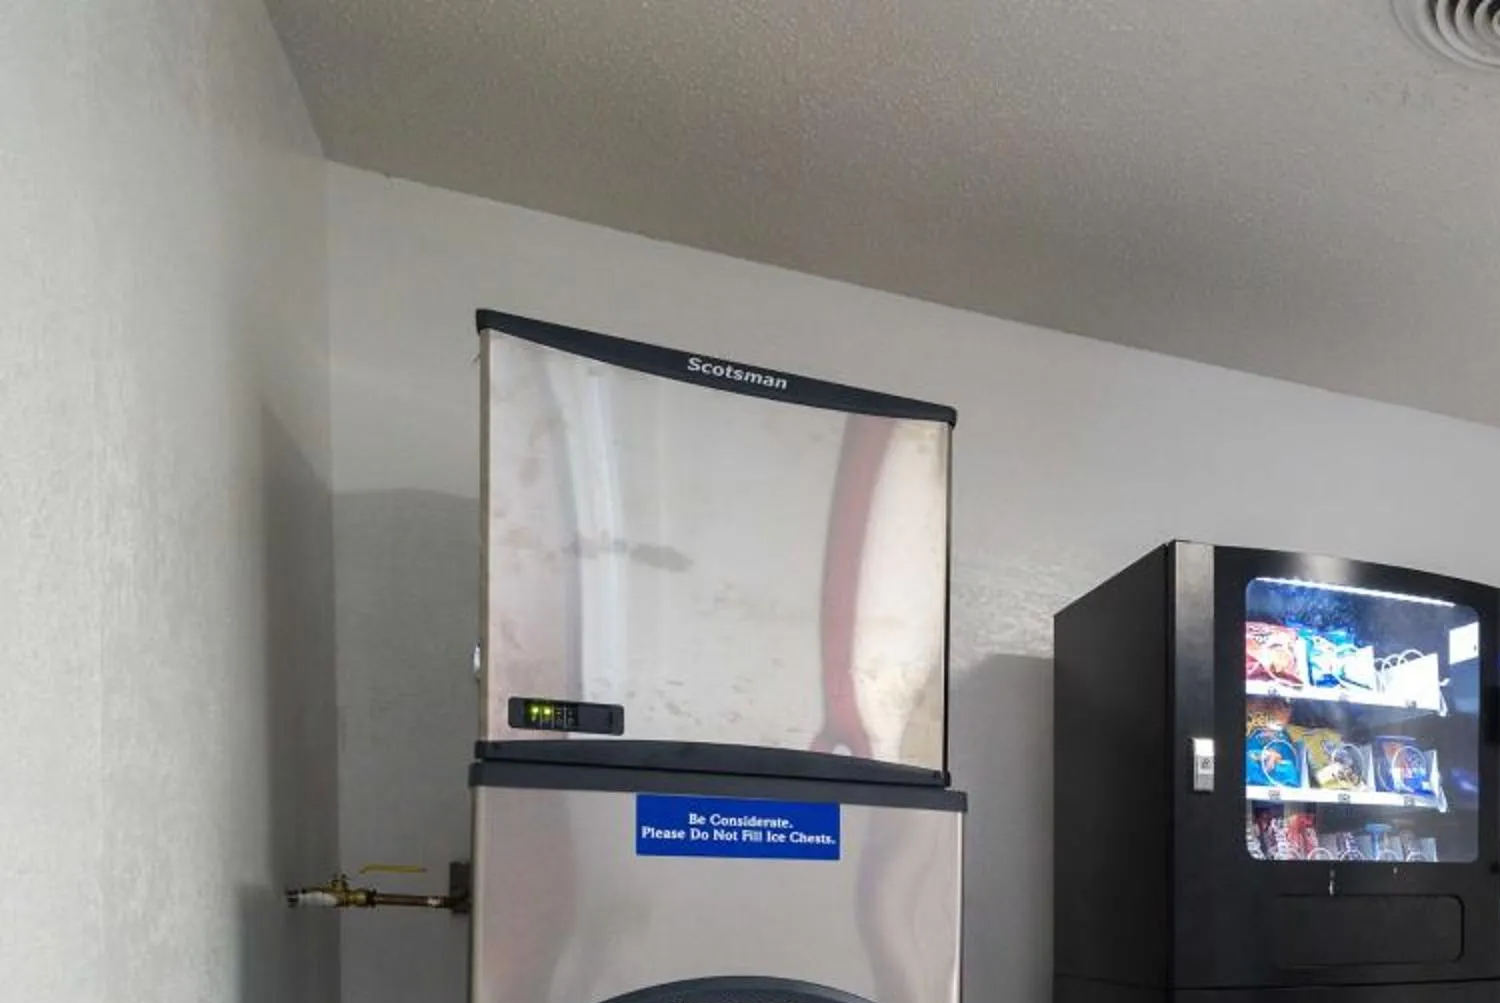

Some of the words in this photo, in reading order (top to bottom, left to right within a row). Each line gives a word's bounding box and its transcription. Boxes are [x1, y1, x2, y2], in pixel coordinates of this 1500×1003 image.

[687, 357, 788, 389] Scotsman
[688, 813, 706, 825] Be
[710, 814, 794, 828] Considerate.
[641, 826, 686, 840] Please
[690, 828, 709, 841] Do
[713, 829, 738, 842] Not
[742, 829, 763, 843] Fill
[767, 831, 786, 843] Ice
[789, 832, 837, 845] Chests.
